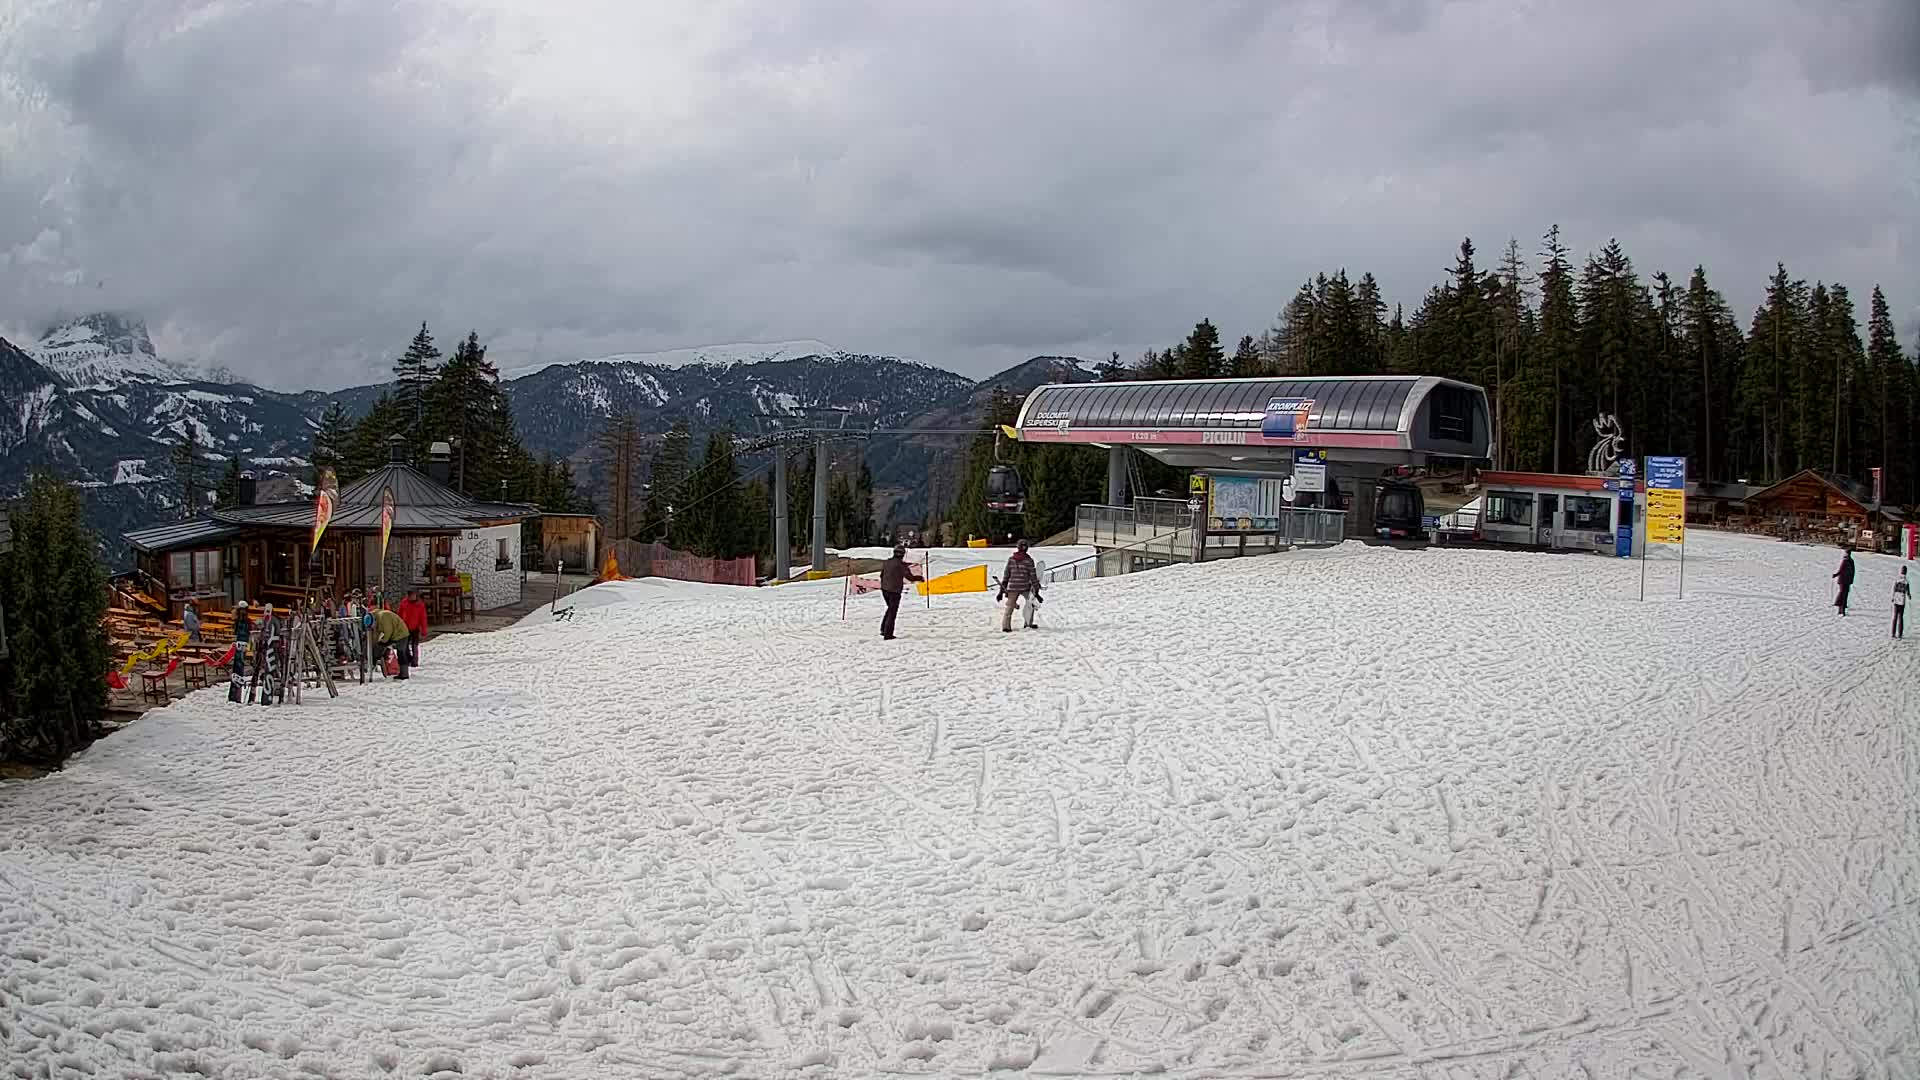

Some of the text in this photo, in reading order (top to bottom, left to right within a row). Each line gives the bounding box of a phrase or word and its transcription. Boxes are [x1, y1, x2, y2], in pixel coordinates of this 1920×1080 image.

[1267, 402, 1312, 410] KRONPLATZ
[1202, 431, 1246, 444] PICULIN
[467, 531, 479, 540] da
